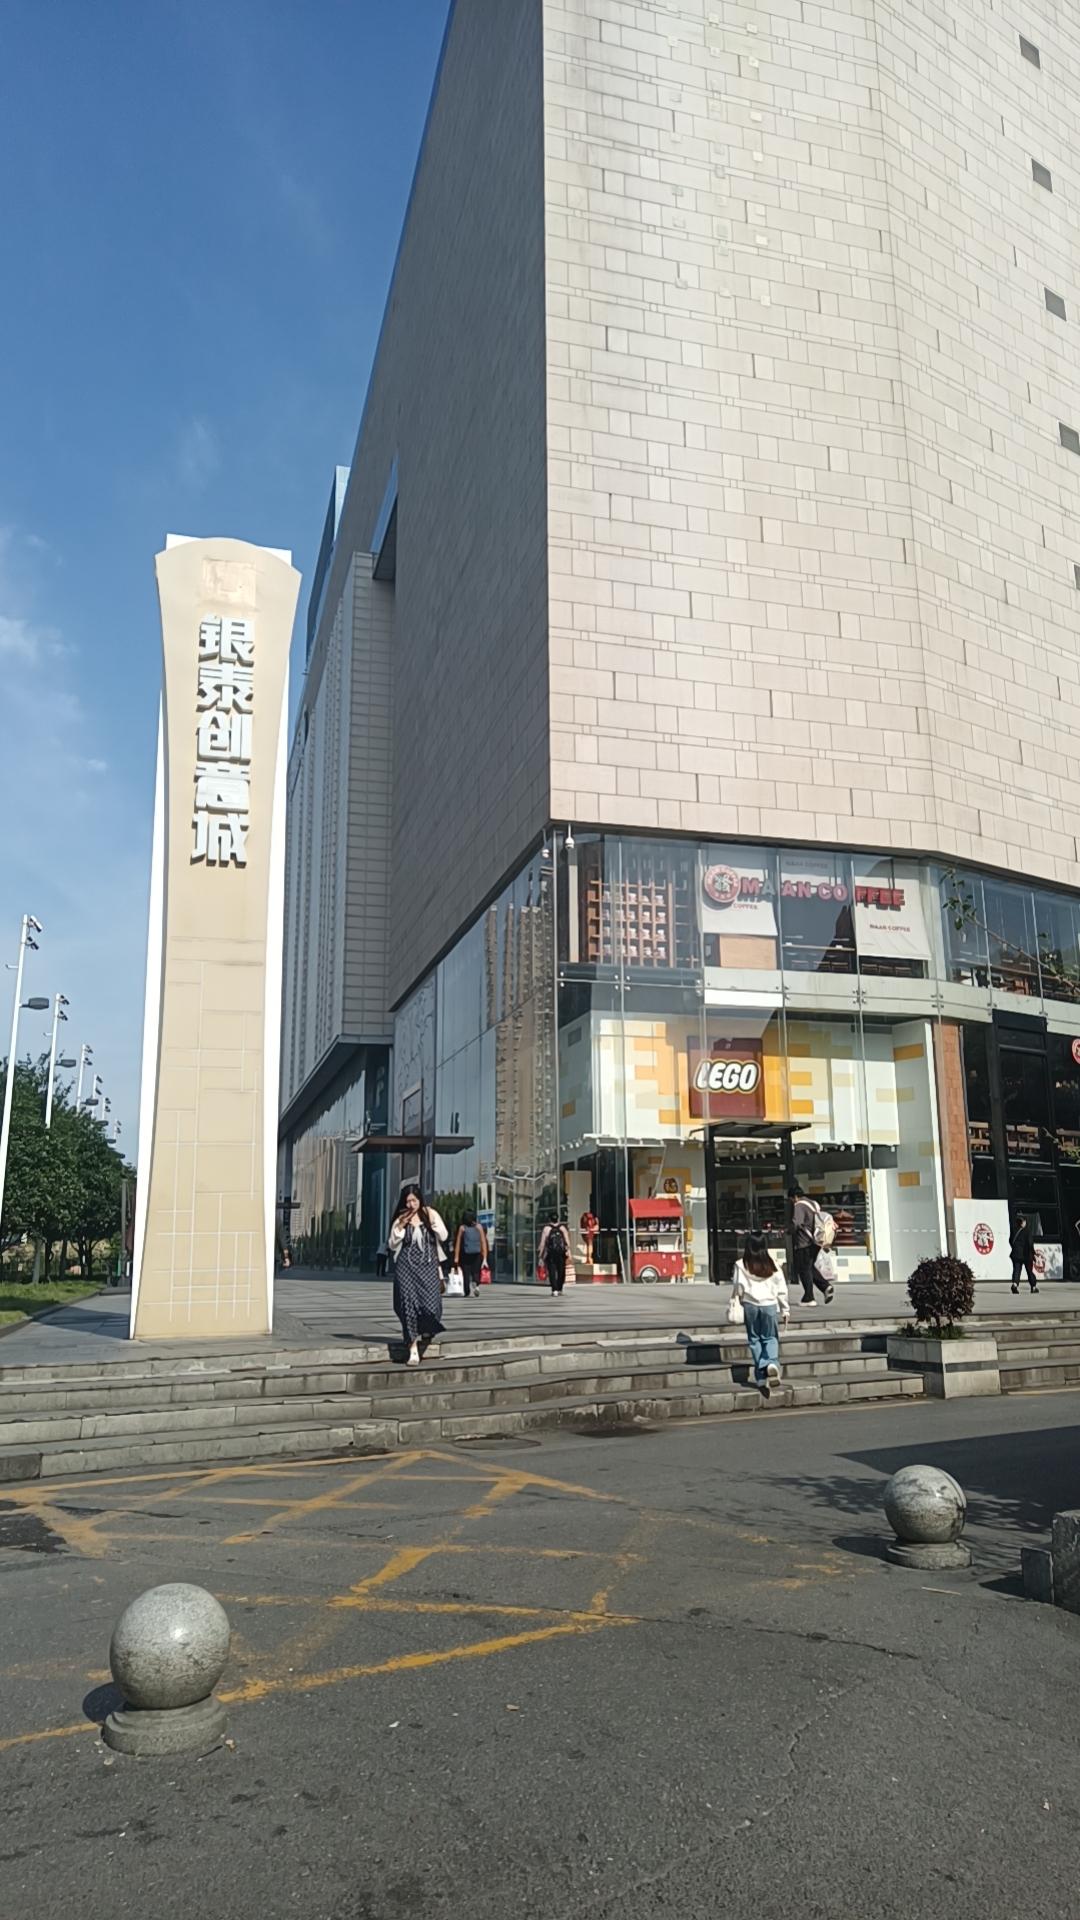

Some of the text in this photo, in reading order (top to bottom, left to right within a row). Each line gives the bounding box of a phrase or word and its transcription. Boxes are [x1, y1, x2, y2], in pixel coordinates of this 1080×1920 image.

[740, 876, 812, 899] MAAN
[816, 882, 906, 907] COFFEE
[695, 1060, 759, 1092] LEGO
